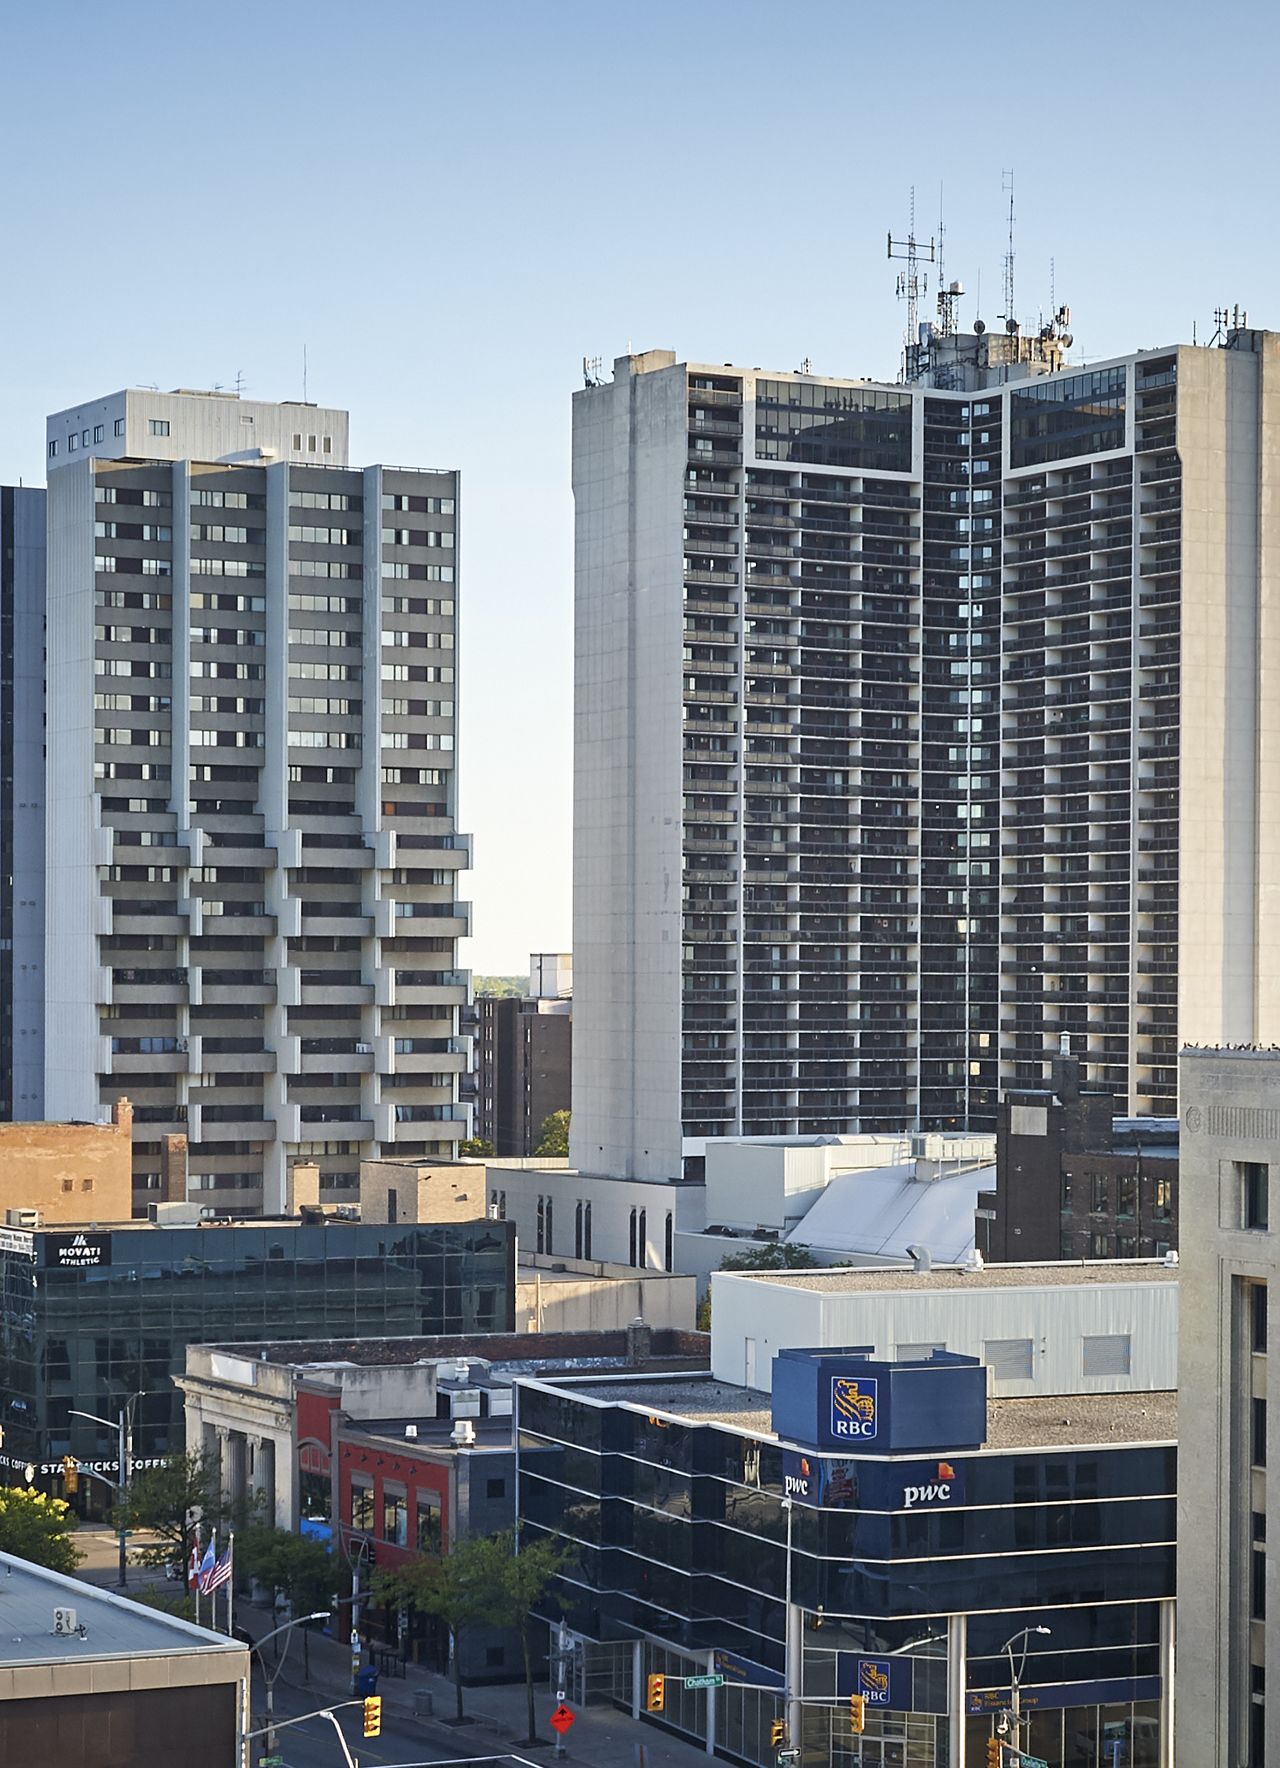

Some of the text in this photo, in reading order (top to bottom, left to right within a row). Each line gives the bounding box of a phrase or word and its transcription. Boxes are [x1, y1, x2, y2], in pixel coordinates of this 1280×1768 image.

[59, 1247, 100, 1257] MOVATI
[60, 1257, 100, 1266] ATHLETIC
[837, 1420, 872, 1435] RBC
[784, 1475, 808, 1496] pwc
[903, 1483, 951, 1508] pwc
[687, 1677, 716, 1688] Chatham
[862, 1690, 887, 1702] RBC
